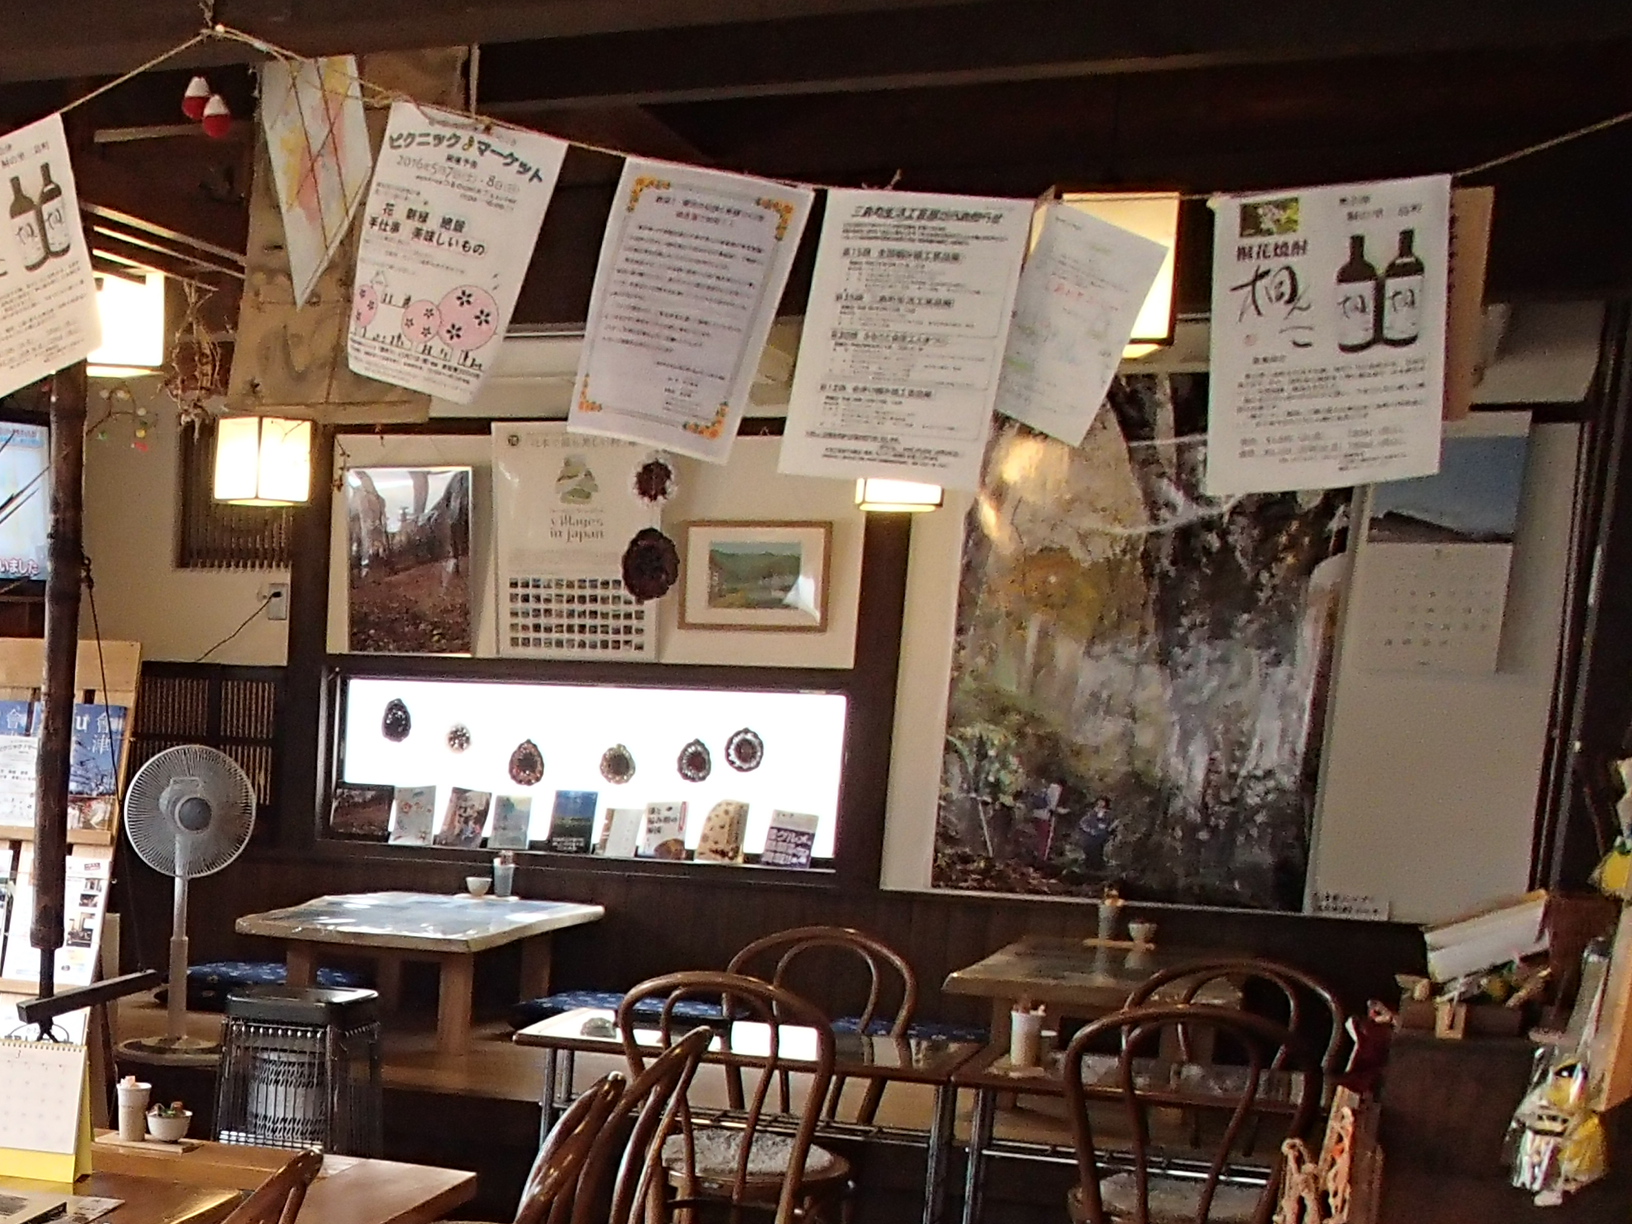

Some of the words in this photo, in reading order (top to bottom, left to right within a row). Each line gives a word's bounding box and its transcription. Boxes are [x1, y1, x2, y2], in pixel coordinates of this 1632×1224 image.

[388, 131, 463, 150] ピクニック
[476, 139, 544, 183] マーケット
